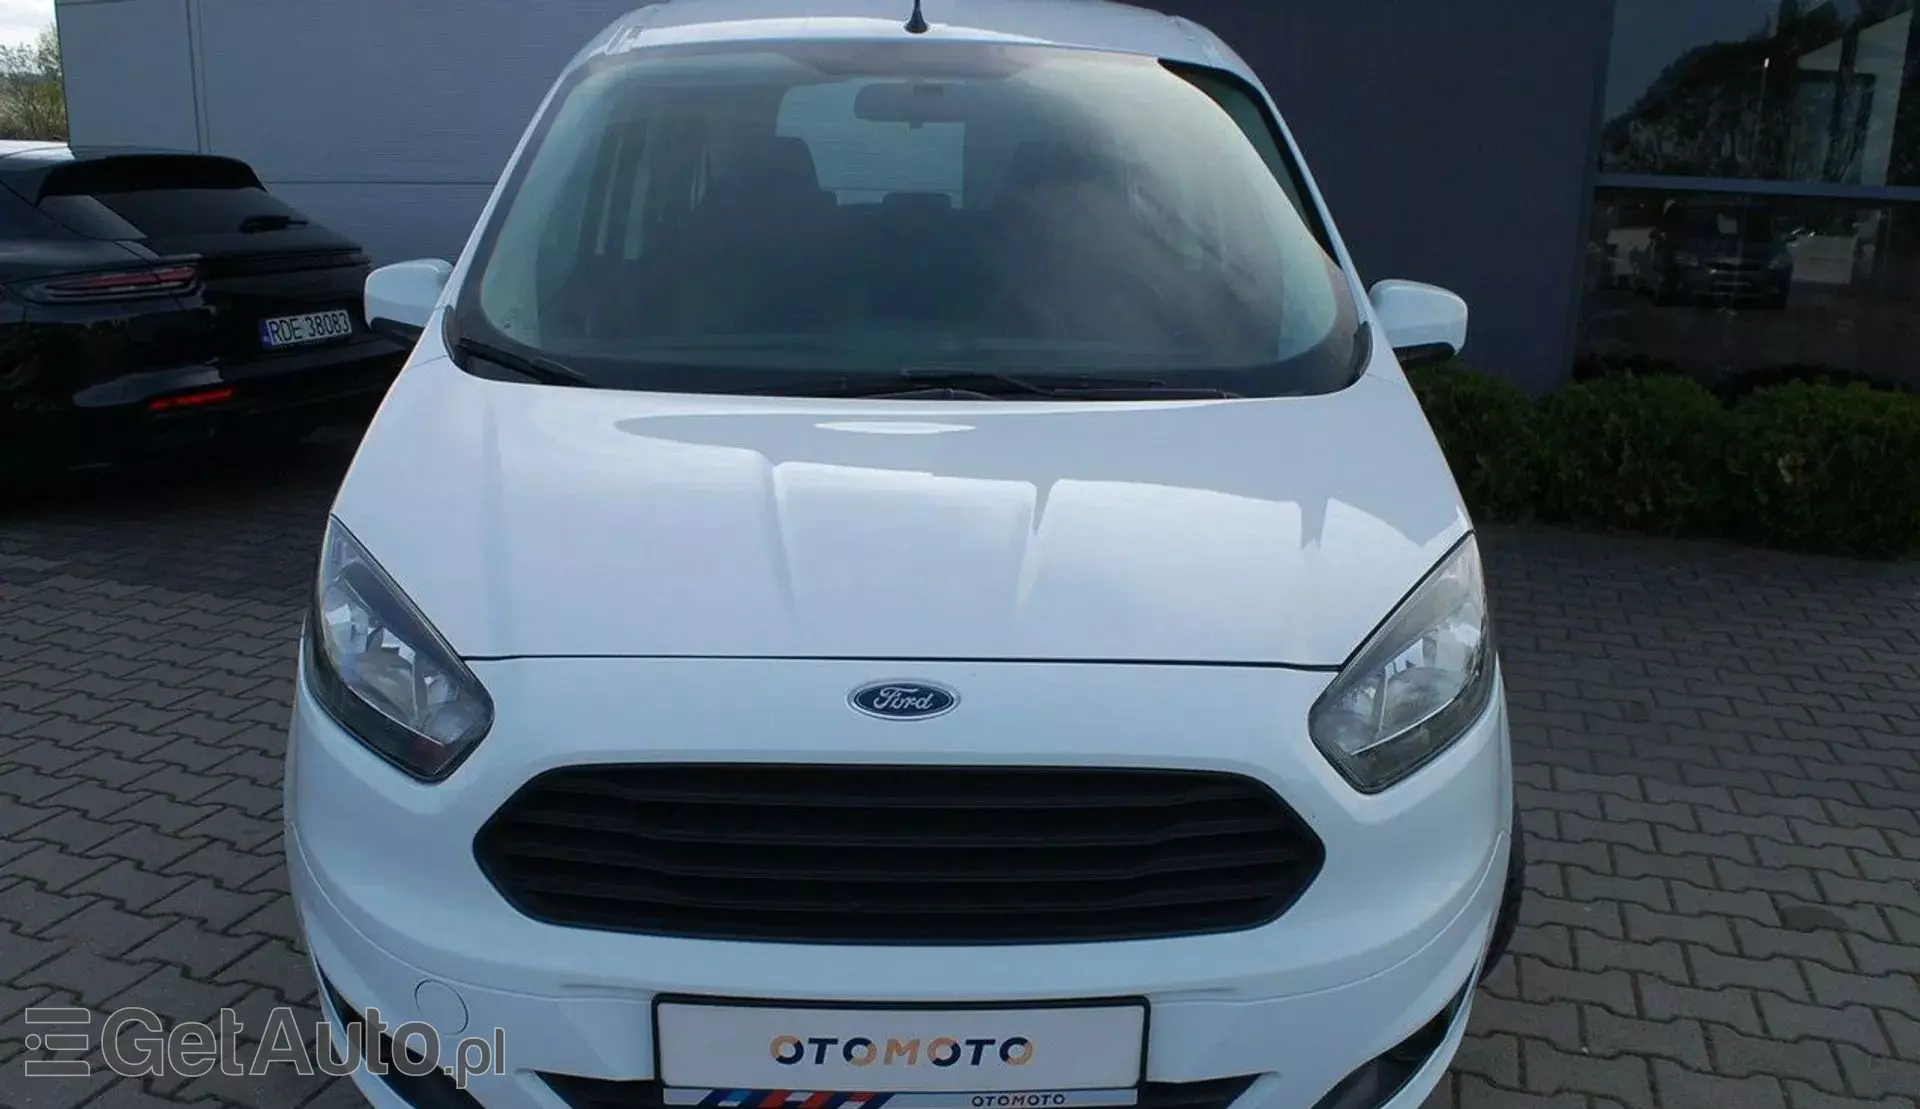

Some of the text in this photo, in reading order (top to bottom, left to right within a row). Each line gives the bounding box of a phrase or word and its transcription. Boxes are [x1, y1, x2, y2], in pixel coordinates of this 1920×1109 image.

[269, 312, 349, 342] RDE 38083
[873, 687, 934, 709] Ford
[770, 1034, 1033, 1066] OTOMOTO
[971, 1093, 1066, 1107] OTOMOTO
